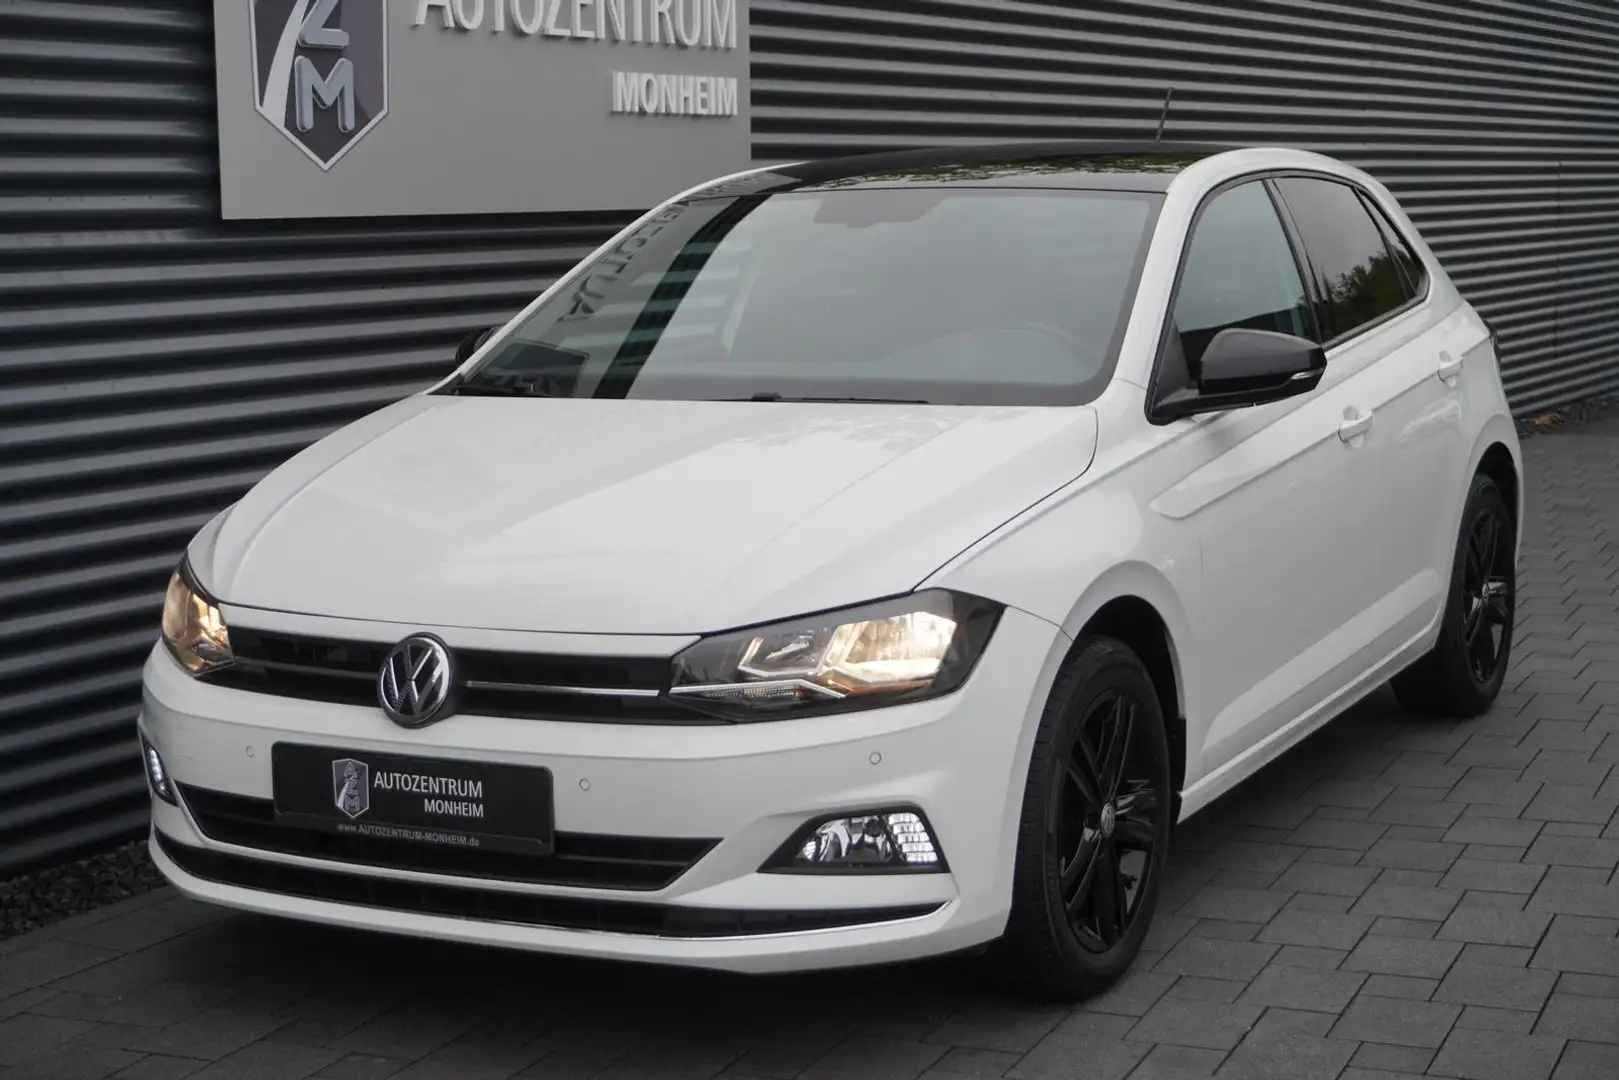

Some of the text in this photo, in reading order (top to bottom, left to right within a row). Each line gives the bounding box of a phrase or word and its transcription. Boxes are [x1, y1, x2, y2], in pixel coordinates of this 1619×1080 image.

[612, 71, 738, 116] MONHEIM
[373, 771, 483, 798] AUTOZENTRUM
[424, 798, 484, 818] MONHEIM
[337, 823, 480, 847] www.AUTOZENTRUM-MONHEIM.de
